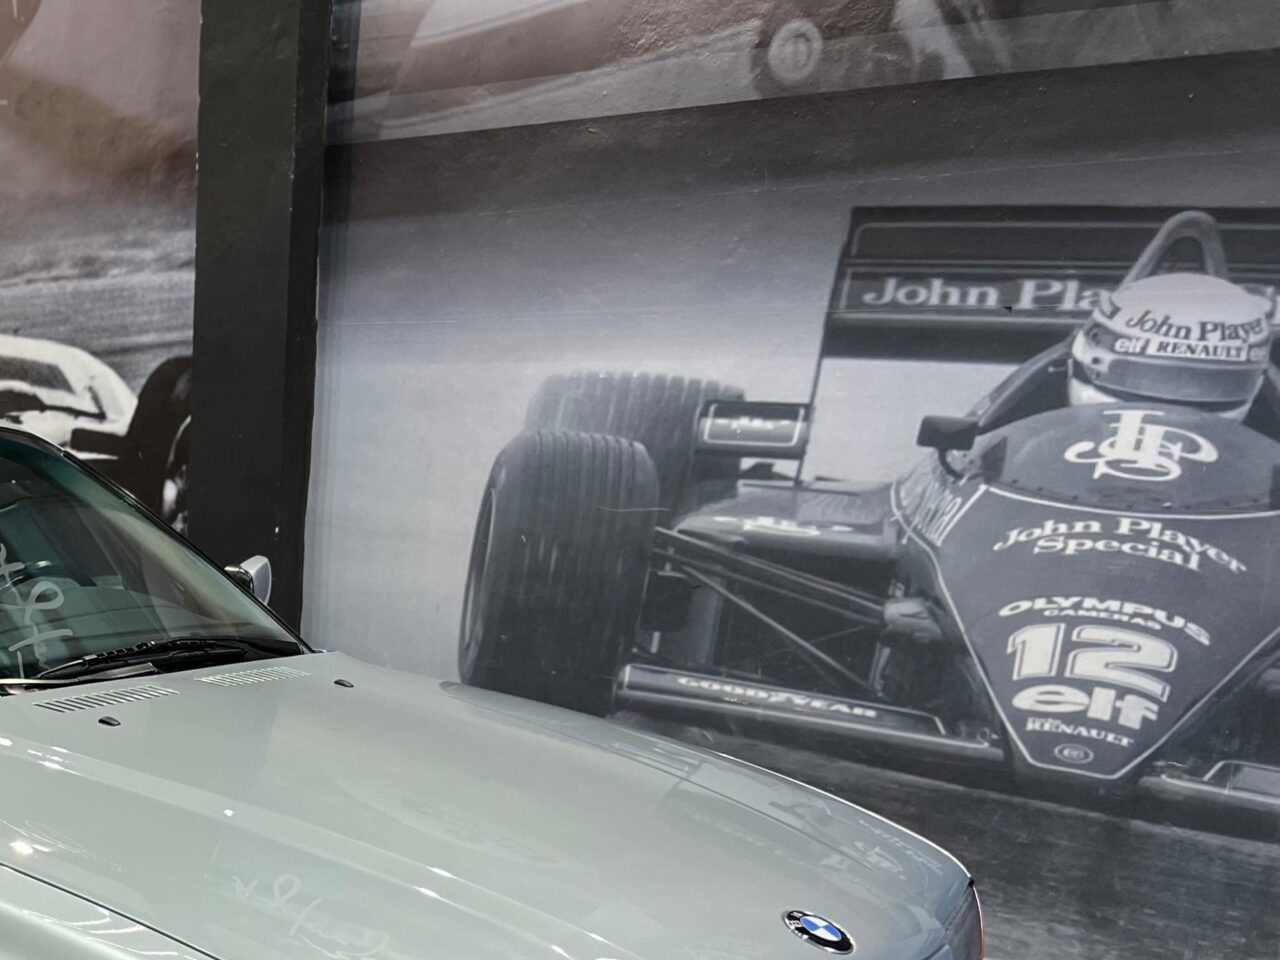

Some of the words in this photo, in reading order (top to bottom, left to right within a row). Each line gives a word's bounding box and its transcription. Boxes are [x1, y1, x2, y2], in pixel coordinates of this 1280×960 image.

[862, 277, 998, 306] John
[1018, 279, 1106, 311] Pla
[1126, 310, 1191, 341] John
[1156, 340, 1243, 359] RENAULT
[993, 517, 1102, 550] John
[1116, 517, 1248, 573] Player
[1033, 534, 1200, 571] Special
[998, 596, 1211, 646] OLYMPUS
[1043, 609, 1162, 630] CAMERAS
[1006, 623, 1178, 703] 12
[1011, 684, 1160, 731] elf
[1025, 721, 1136, 748] RENAULT
